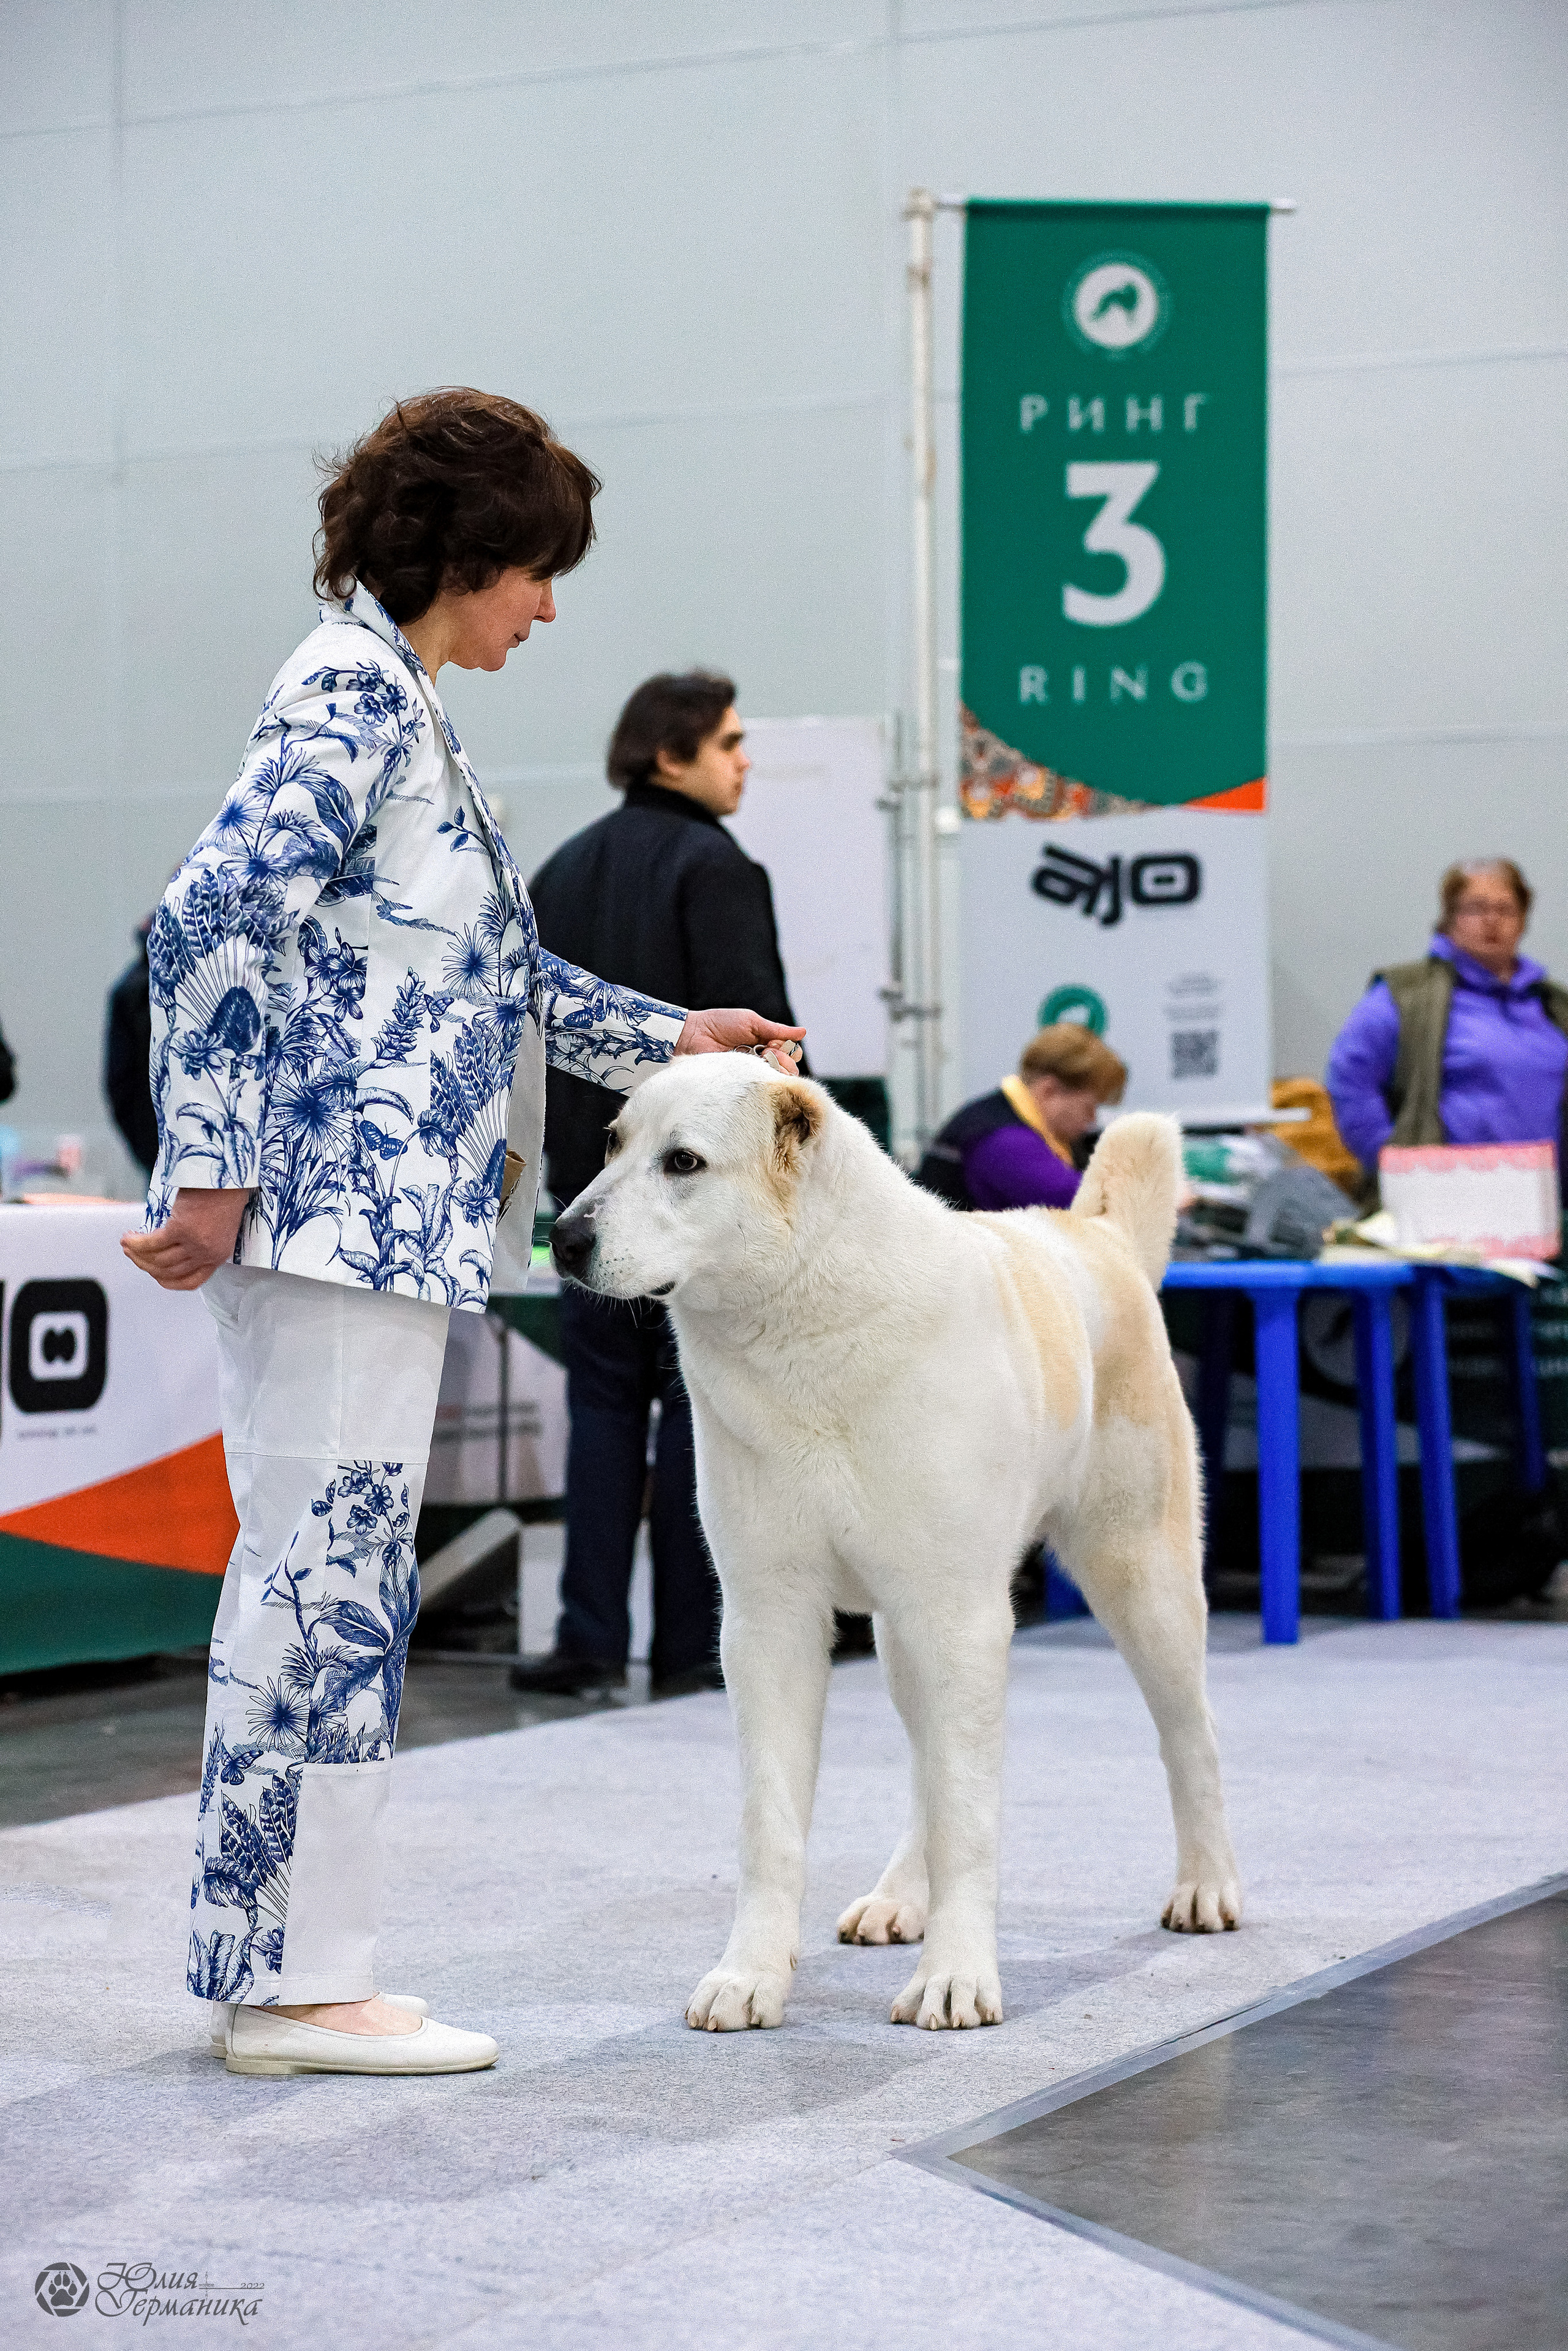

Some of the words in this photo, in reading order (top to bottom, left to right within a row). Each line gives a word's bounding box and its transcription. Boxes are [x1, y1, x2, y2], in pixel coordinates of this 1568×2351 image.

[1020, 394, 1210, 434] РИНГ
[1062, 461, 1165, 626] 3
[1019, 662, 1208, 704] RING
